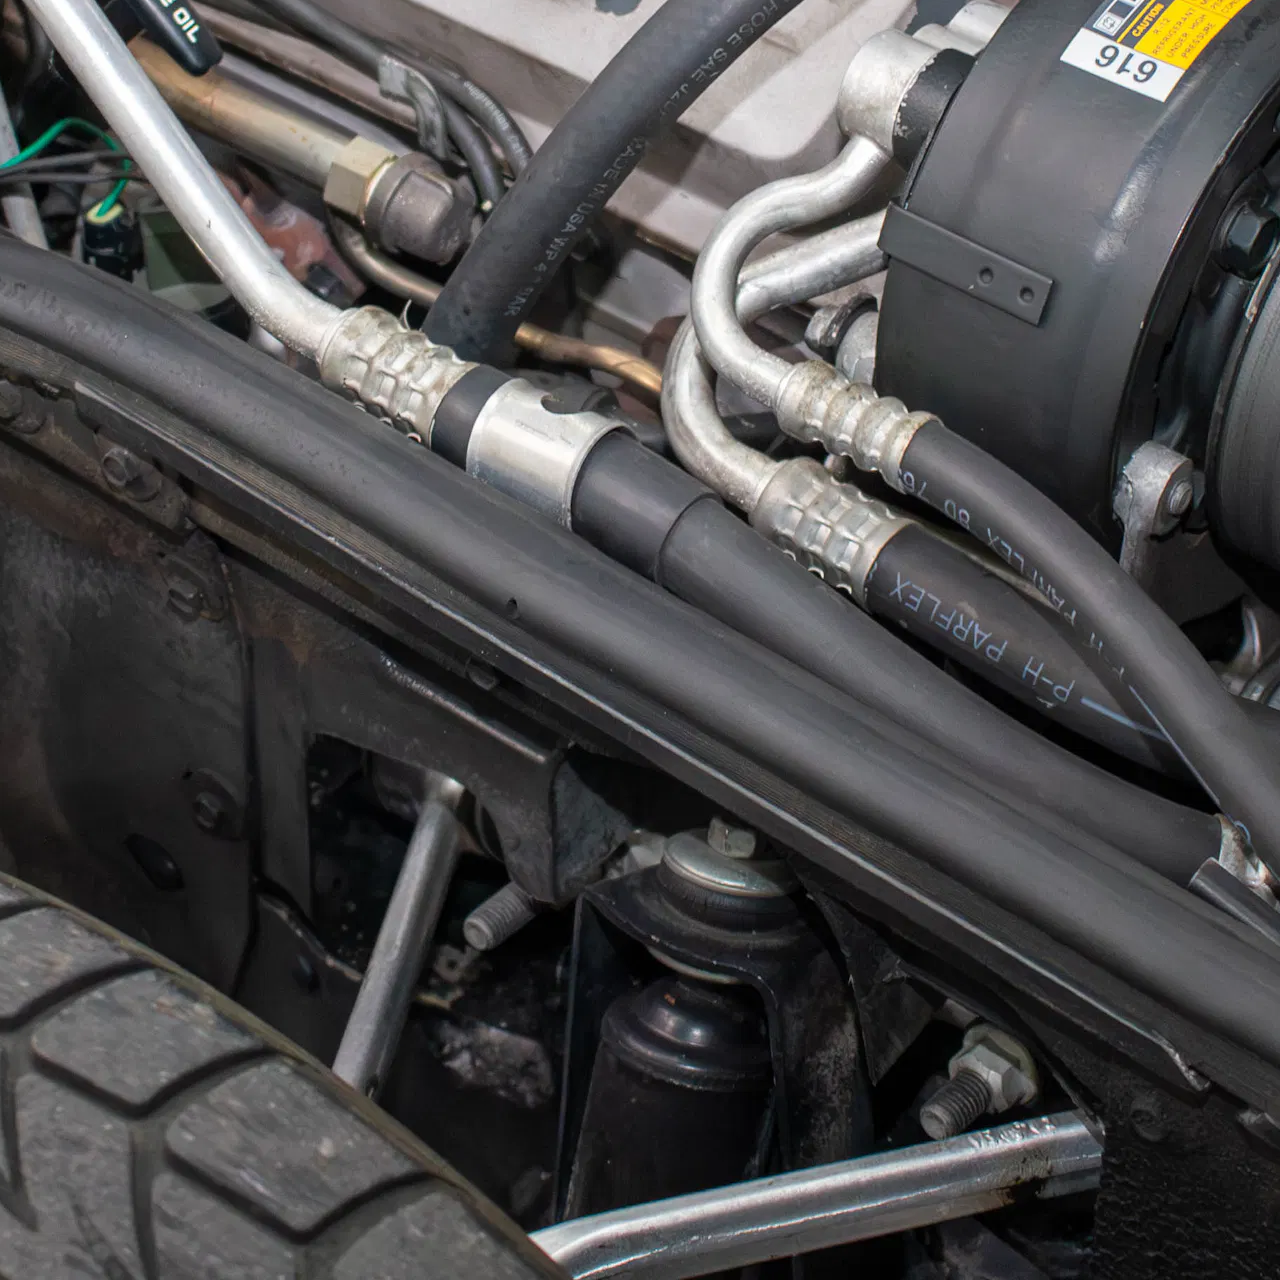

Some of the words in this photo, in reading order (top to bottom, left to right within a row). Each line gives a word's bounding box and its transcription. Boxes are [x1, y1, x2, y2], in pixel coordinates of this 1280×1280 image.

[172, 7, 200, 43] OIL
[727, 0, 778, 48] HOSE
[1132, 3, 1165, 37] CAUTION
[1166, 32, 1188, 58] UNDER
[691, 47, 728, 83] SAE
[561, 202, 595, 233] USA
[889, 572, 1008, 663] PARFLEX
[1022, 656, 1075, 703] P-H
